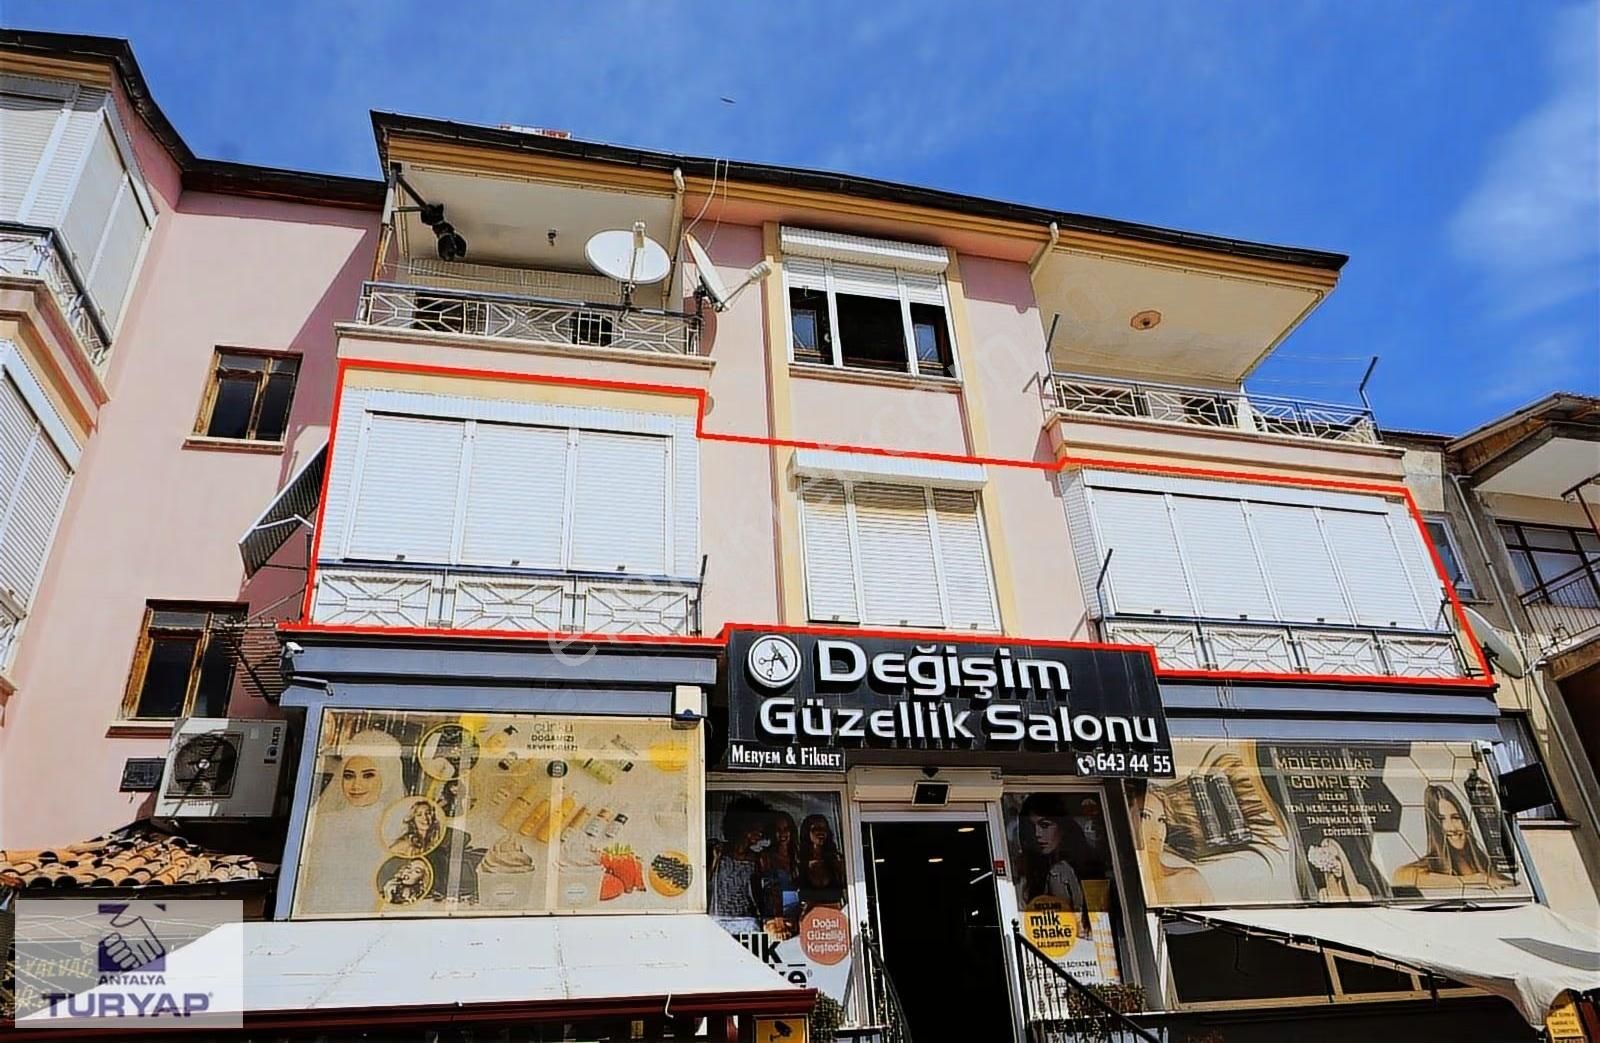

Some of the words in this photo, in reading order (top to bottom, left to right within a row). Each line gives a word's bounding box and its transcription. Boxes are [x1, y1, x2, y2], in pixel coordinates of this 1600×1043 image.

[817, 639, 1071, 699] Değişim
[760, 697, 974, 740] Güzellik
[984, 704, 1158, 743] Salonu
[785, 746, 797, 765] &
[1097, 753, 1125, 771] 643
[1129, 754, 1149, 772] 44
[1153, 755, 1171, 773] 55
[1275, 757, 1375, 771] MOLECULAR
[1290, 775, 1370, 789] COMPLEX
[812, 918, 839, 930] Doğal
[1030, 910, 1061, 926] milk
[1032, 925, 1072, 939] shake
[733, 933, 783, 964] ilk
